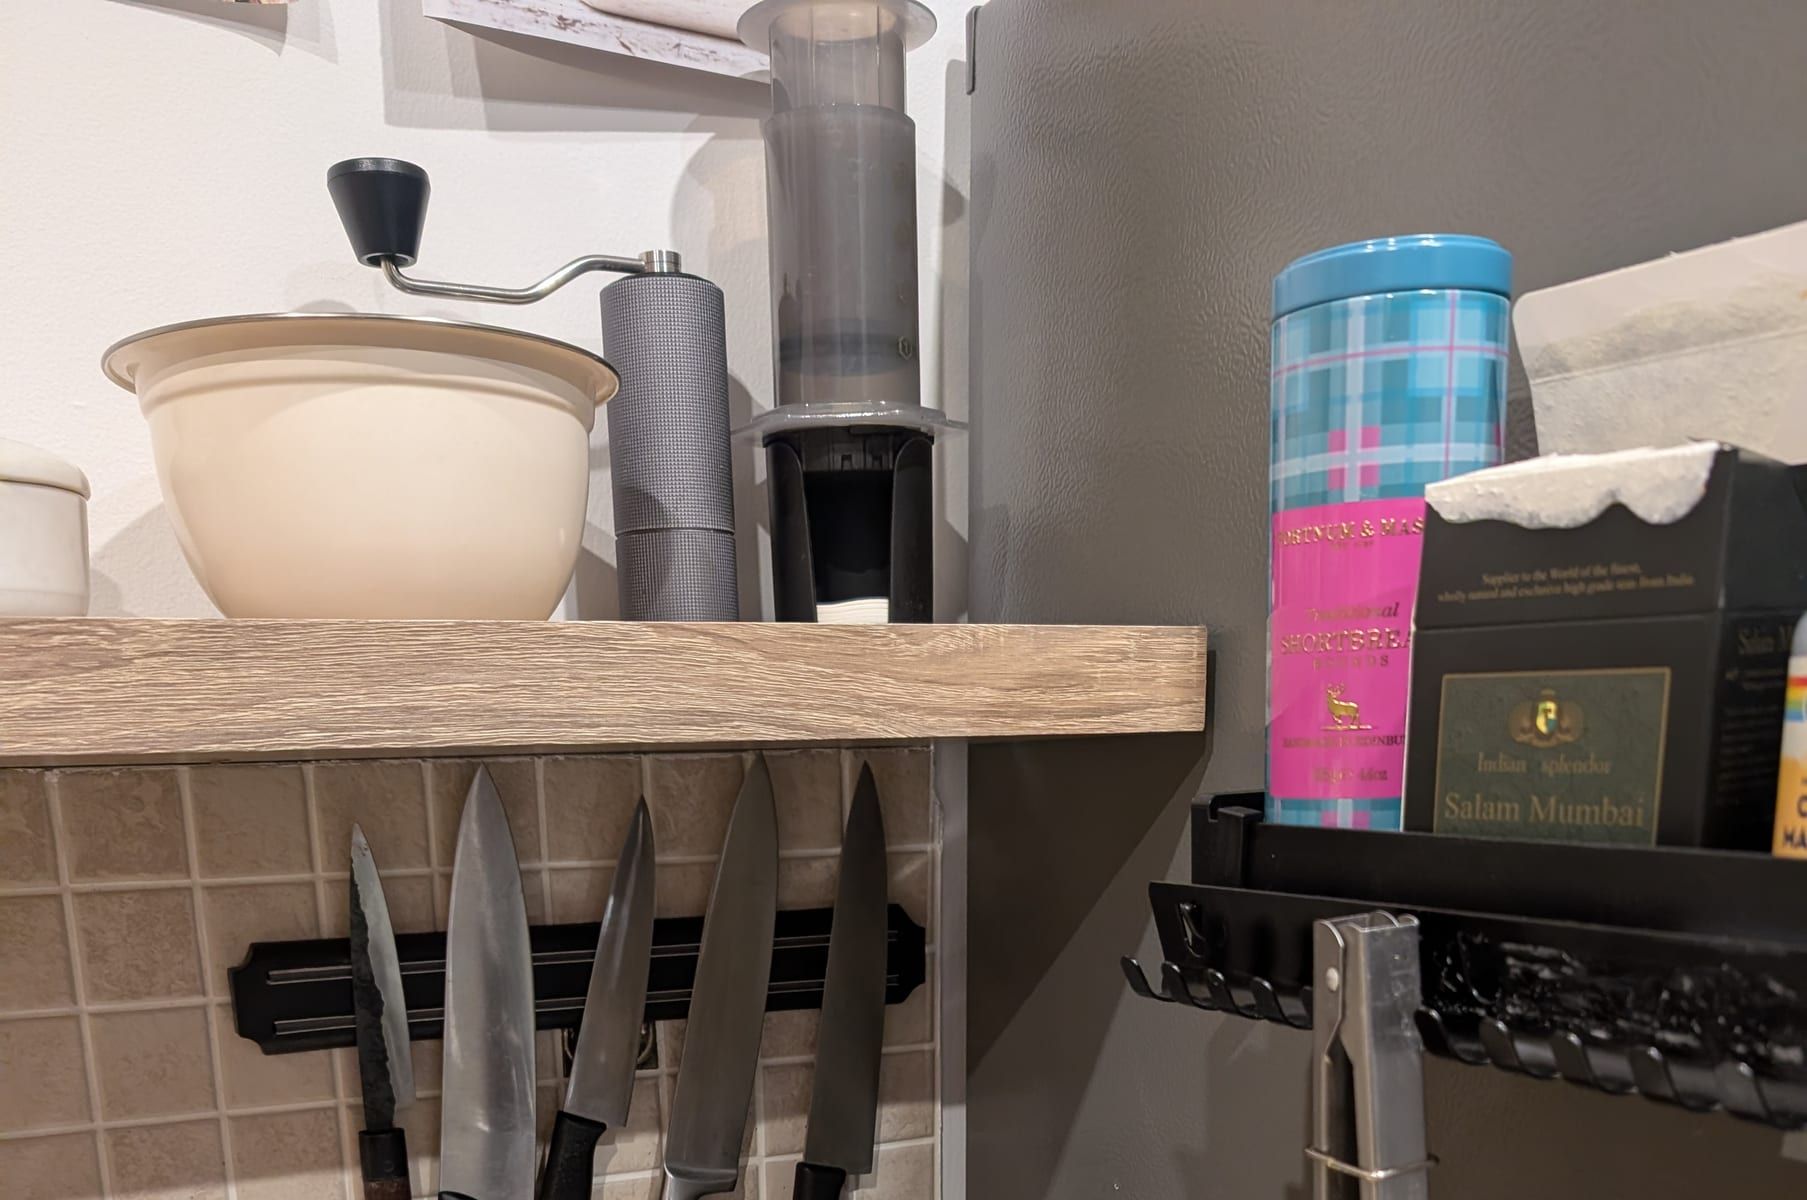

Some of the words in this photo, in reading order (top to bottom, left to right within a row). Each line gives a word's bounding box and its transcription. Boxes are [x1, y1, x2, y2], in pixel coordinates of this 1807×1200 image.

[1360, 519, 1376, 537] &
[1477, 752, 1527, 774] Indian
[1444, 792, 1520, 822] Salam
[1528, 794, 1645, 827] Mumbai
